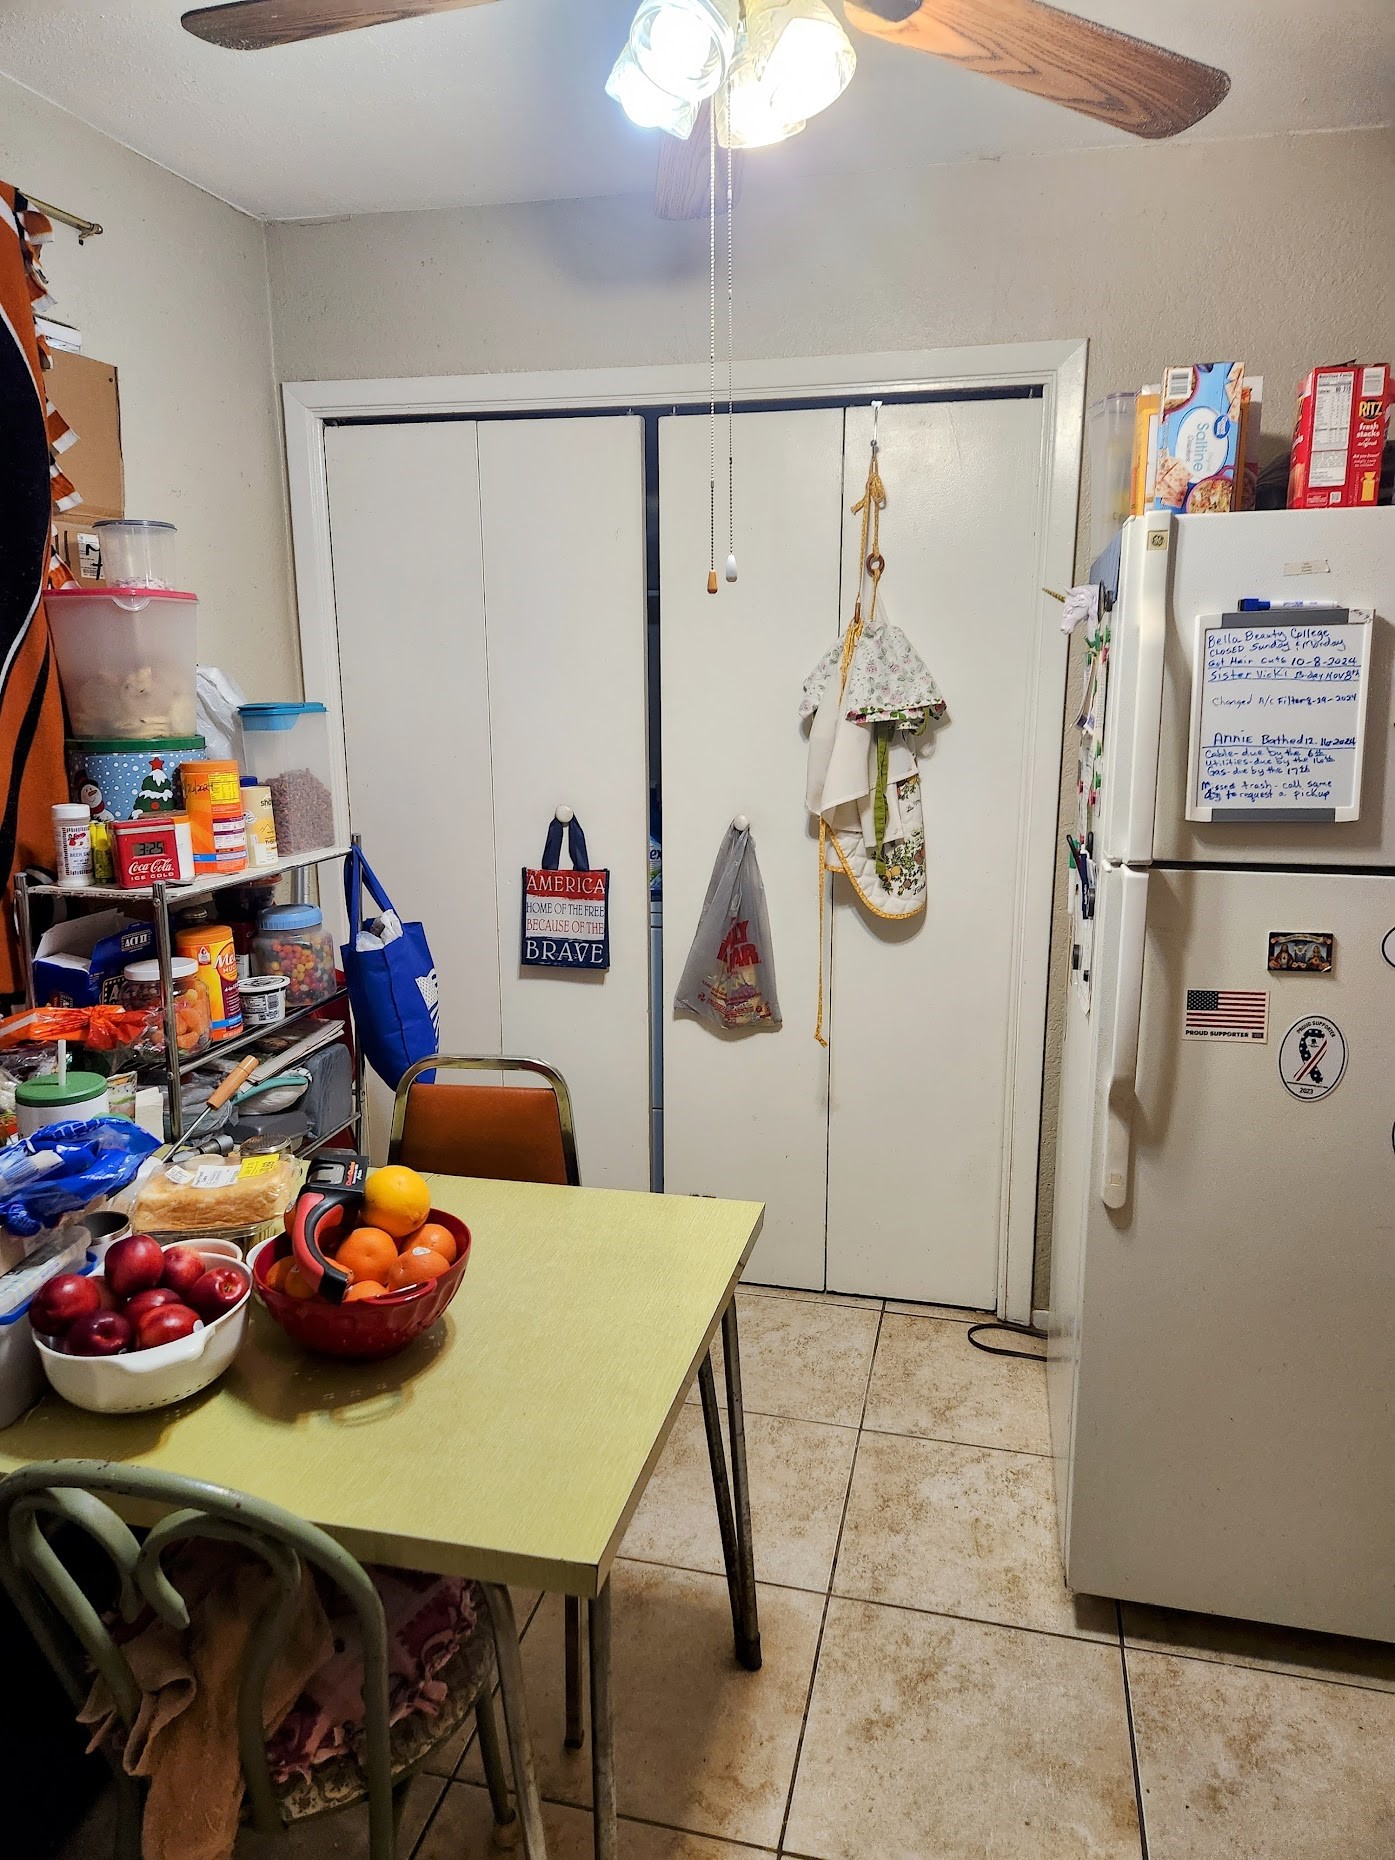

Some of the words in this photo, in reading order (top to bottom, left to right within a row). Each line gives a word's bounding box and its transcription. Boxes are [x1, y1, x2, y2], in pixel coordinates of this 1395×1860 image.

[1359, 401, 1383, 417] RITZ
[1359, 421, 1379, 431] fresh
[1356, 430, 1381, 438] stacks
[1193, 422, 1209, 472] Saltine
[1208, 633, 1242, 649] Bella
[1245, 629, 1287, 643] Beauty
[1291, 628, 1330, 642] College
[1209, 645, 1244, 657] CLOSED
[1249, 639, 1291, 652] Sunday
[1302, 636, 1346, 652] Monday
[1230, 655, 1254, 666] Hair
[1209, 669, 1252, 681] Sister
[1212, 693, 1252, 709] Changed
[1266, 747, 1284, 760] by
[1285, 748, 1301, 757] the
[1250, 765, 1265, 777] by
[1265, 765, 1284, 774] the
[1307, 780, 1332, 789] same
[139, 842, 164, 855] 3:25
[128, 858, 174, 875] Coca-Cola
[150, 871, 174, 879] COLD
[526, 875, 605, 894] AMERICA
[526, 901, 553, 914] HOME
[553, 902, 567, 915] OF
[567, 903, 583, 916] THE
[584, 905, 605, 917] FREE
[526, 918, 570, 933] BECAUSE
[571, 920, 585, 934] OF
[586, 921, 604, 935] THE
[124, 936, 139, 948] ACT
[525, 940, 604, 964] BRAVE
[1296, 1021, 1312, 1034] PROUD
[1312, 1020, 1336, 1038] SUPPORTER
[1299, 1087, 1314, 1095] 2023
